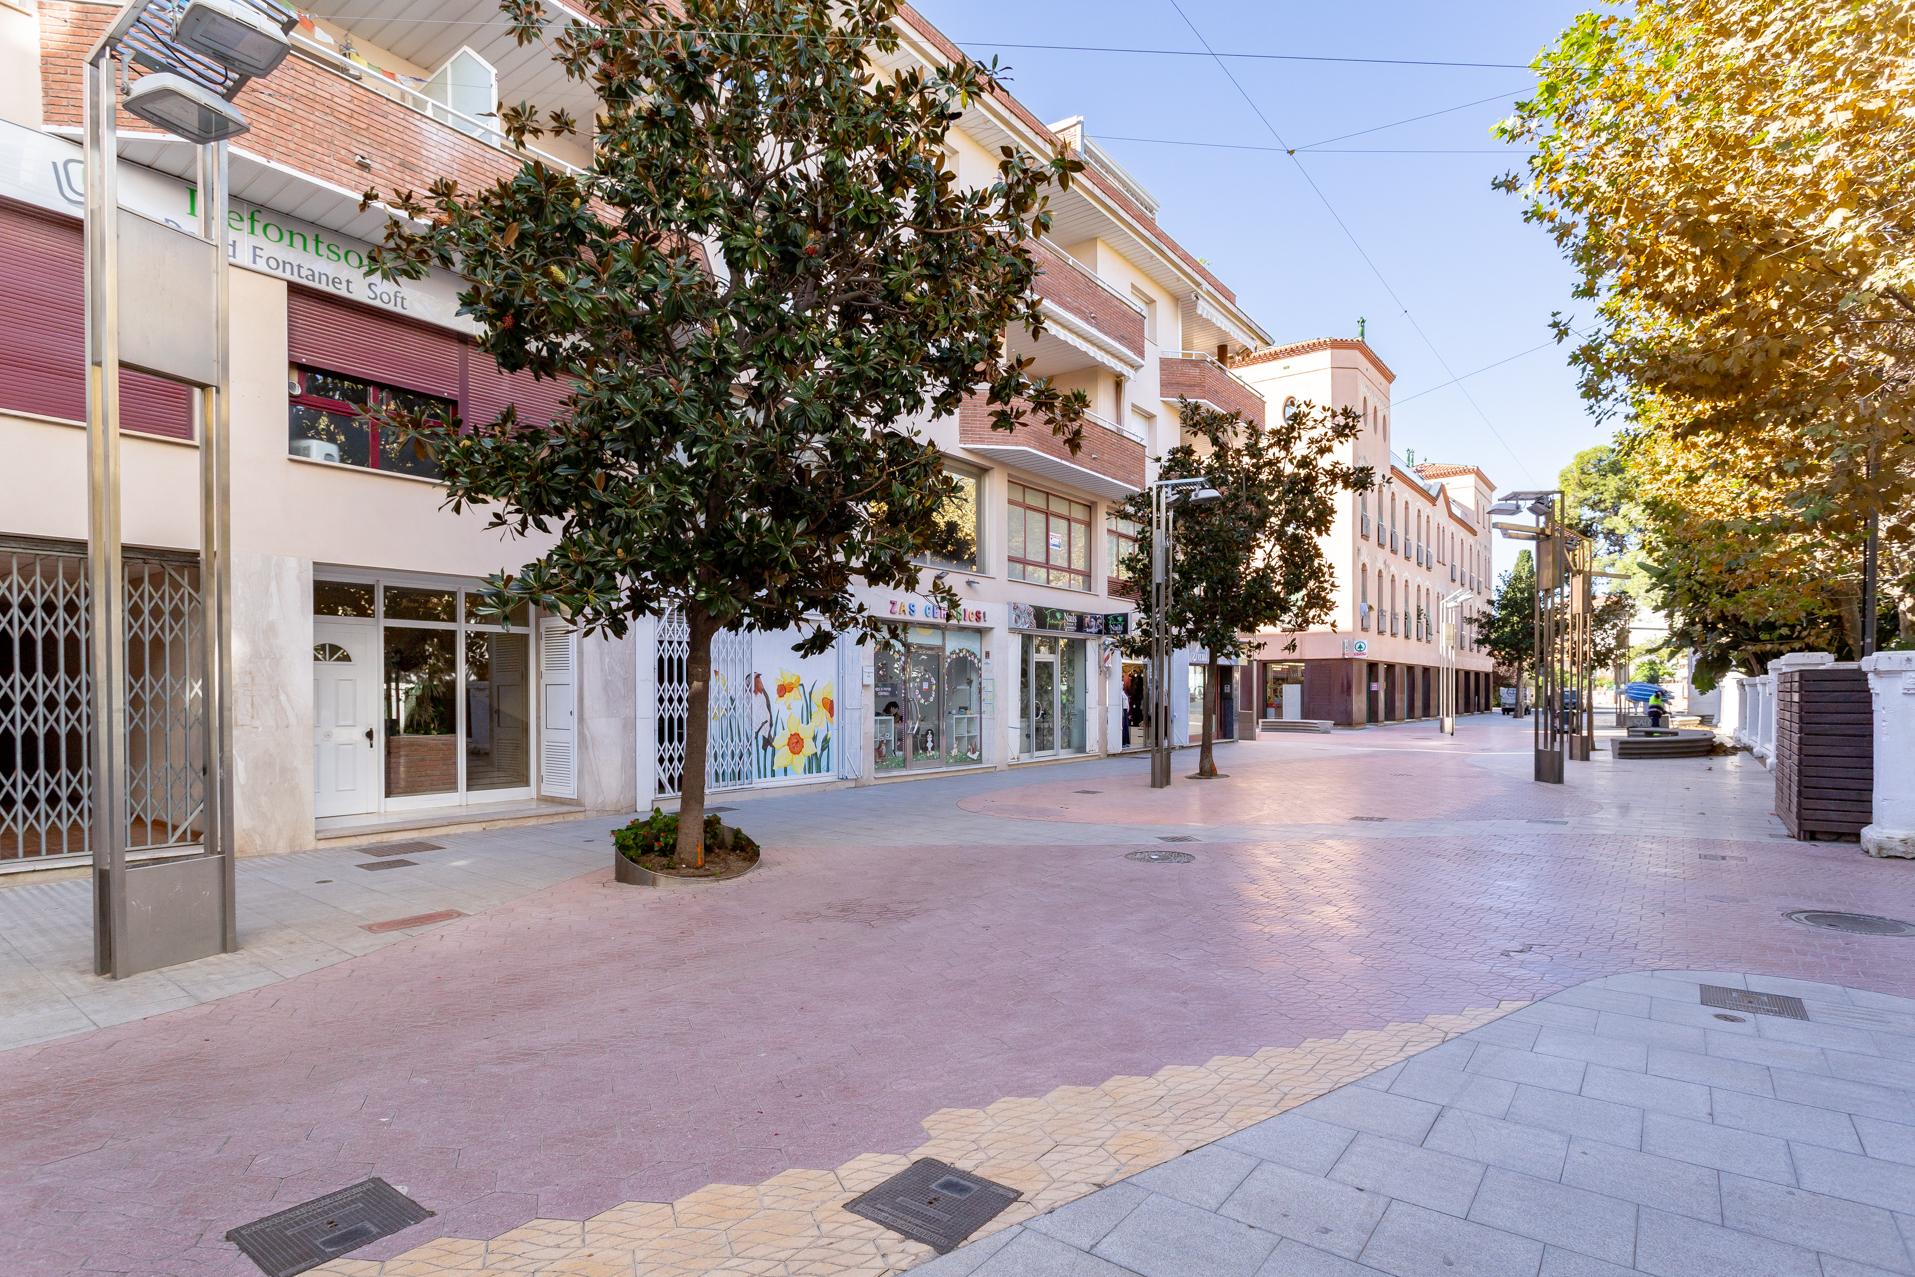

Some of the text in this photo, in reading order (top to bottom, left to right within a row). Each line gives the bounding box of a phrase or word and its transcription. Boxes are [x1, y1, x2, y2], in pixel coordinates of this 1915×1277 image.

[252, 245, 408, 310] Fontanet Soft
[889, 600, 917, 617] ZAS
